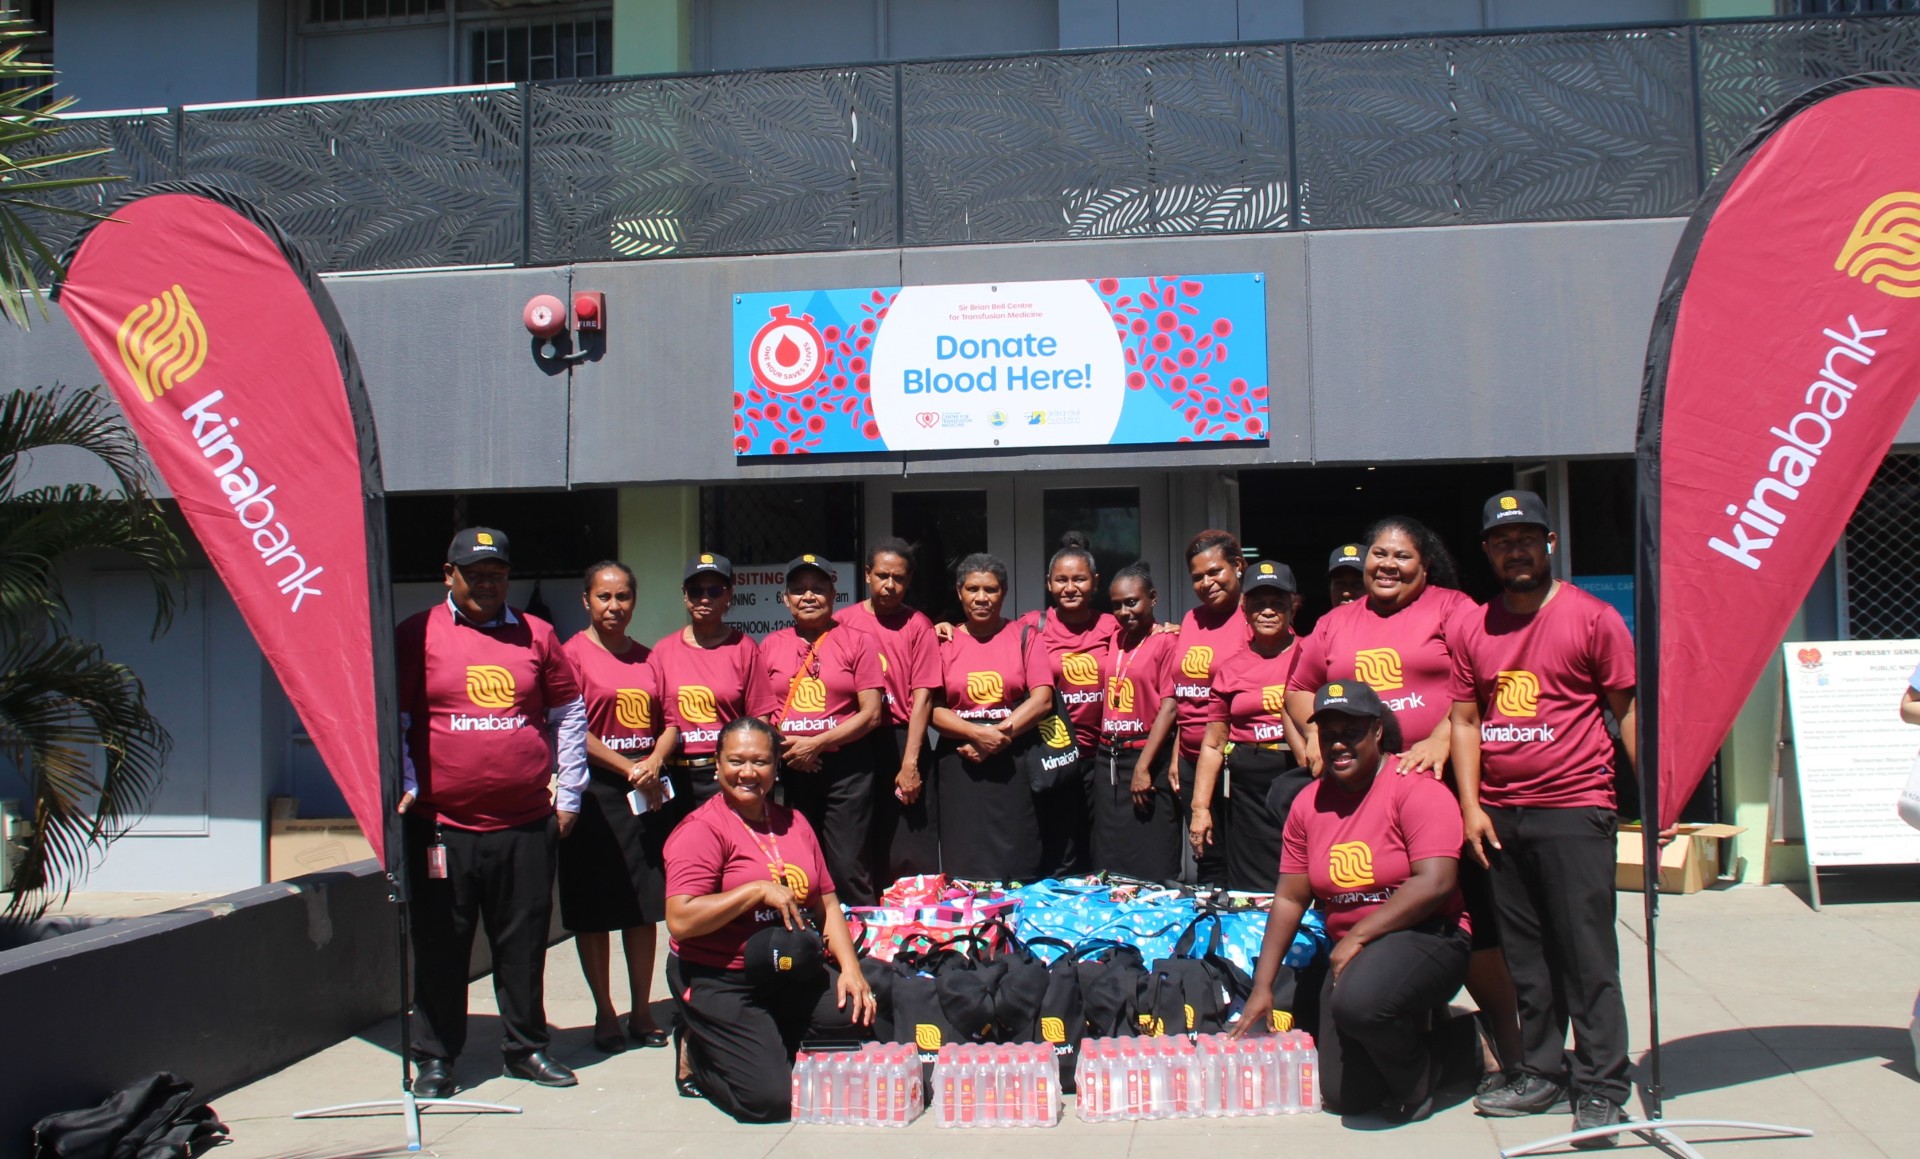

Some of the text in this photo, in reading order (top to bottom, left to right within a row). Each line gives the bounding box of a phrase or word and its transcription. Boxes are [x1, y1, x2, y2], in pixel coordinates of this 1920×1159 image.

[949, 310, 1043, 321] for Transfusion Medicine
[958, 301, 1033, 312] Sir Brian Bell Centre
[577, 320, 597, 328] FIRE
[936, 333, 1057, 360] Donate
[766, 361, 783, 379] HOUR
[783, 367, 805, 380] SAVES
[802, 341, 812, 362] LIVES
[903, 363, 1092, 394] Blood Here!
[1708, 314, 1888, 570] kinabank
[181, 389, 324, 613] kinabank
[732, 571, 785, 586] ISITING
[731, 592, 756, 606] NING
[449, 713, 526, 732] kinabank
[1253, 723, 1284, 741] kina
[1481, 723, 1556, 743] kinabank
[602, 734, 656, 750] kinaban
[1053, 1043, 1074, 1056] bank
